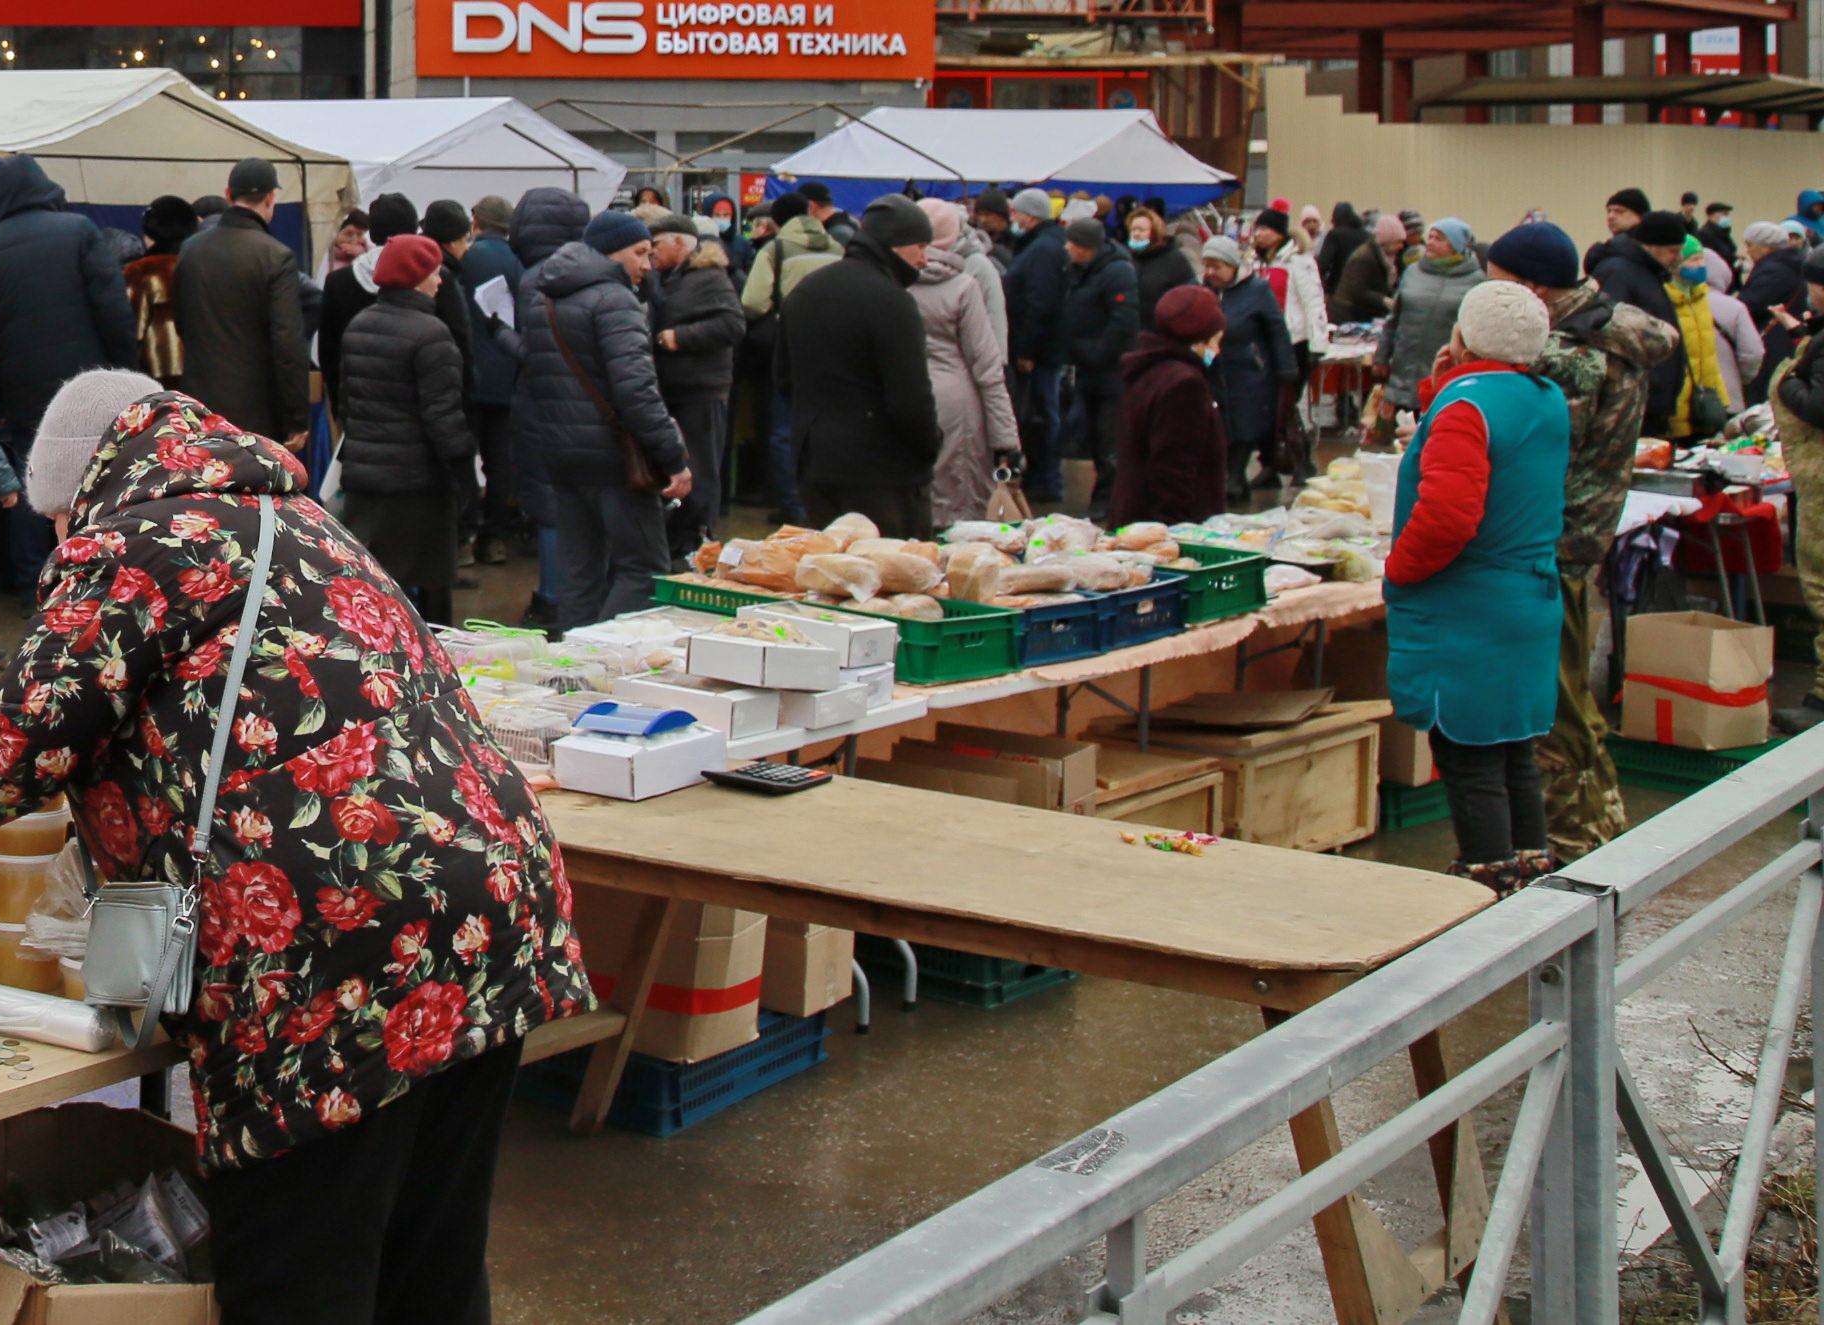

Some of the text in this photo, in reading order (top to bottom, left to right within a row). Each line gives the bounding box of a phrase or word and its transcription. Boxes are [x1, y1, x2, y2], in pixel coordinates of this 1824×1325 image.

[452, 2, 647, 54] DNS
[656, 3, 834, 28] ЦИФРОВАЯ И
[656, 32, 907, 57] БЫТОВАЯ ТЕХНИКА
